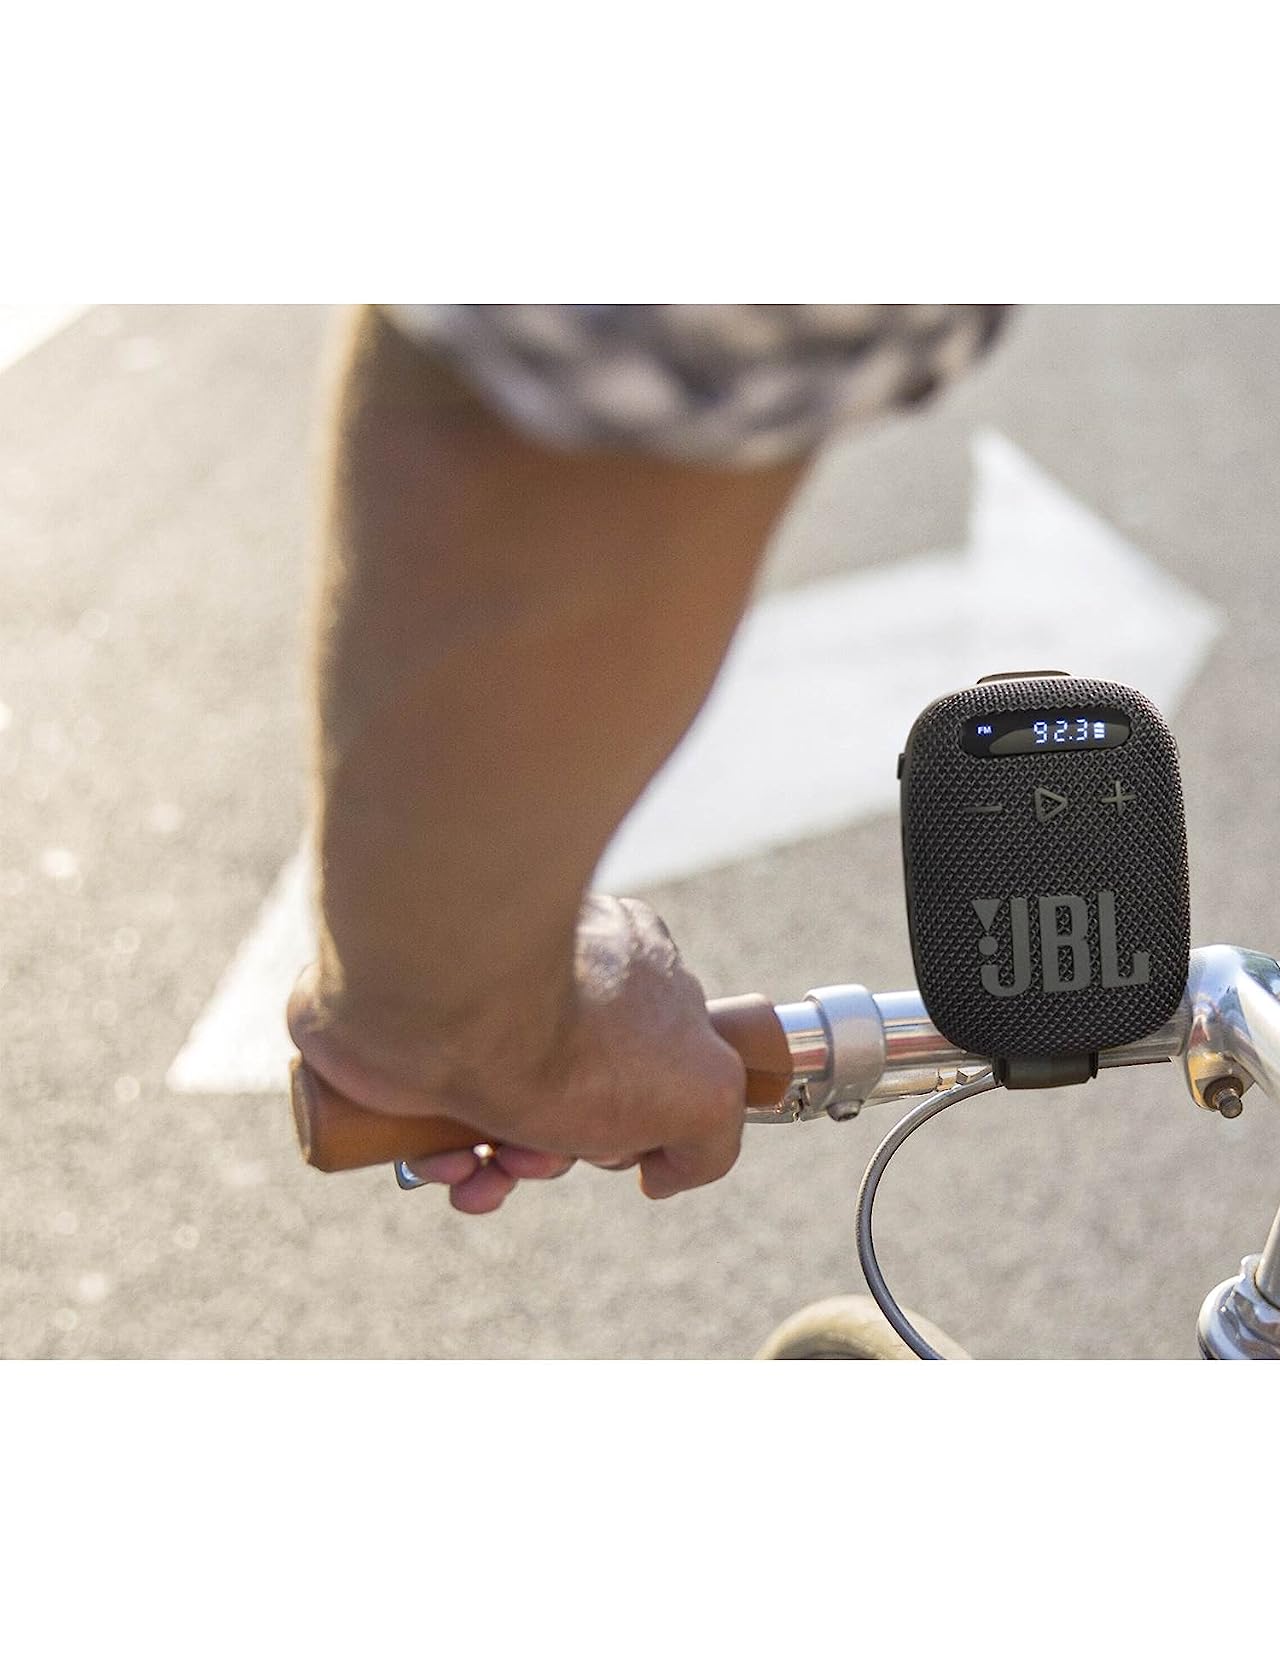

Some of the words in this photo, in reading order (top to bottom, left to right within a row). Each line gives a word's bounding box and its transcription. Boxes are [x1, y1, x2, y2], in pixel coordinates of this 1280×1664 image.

[977, 725, 992, 735] FM
[1034, 718, 1088, 744] 92.3
[974, 890, 1150, 997] JBL
